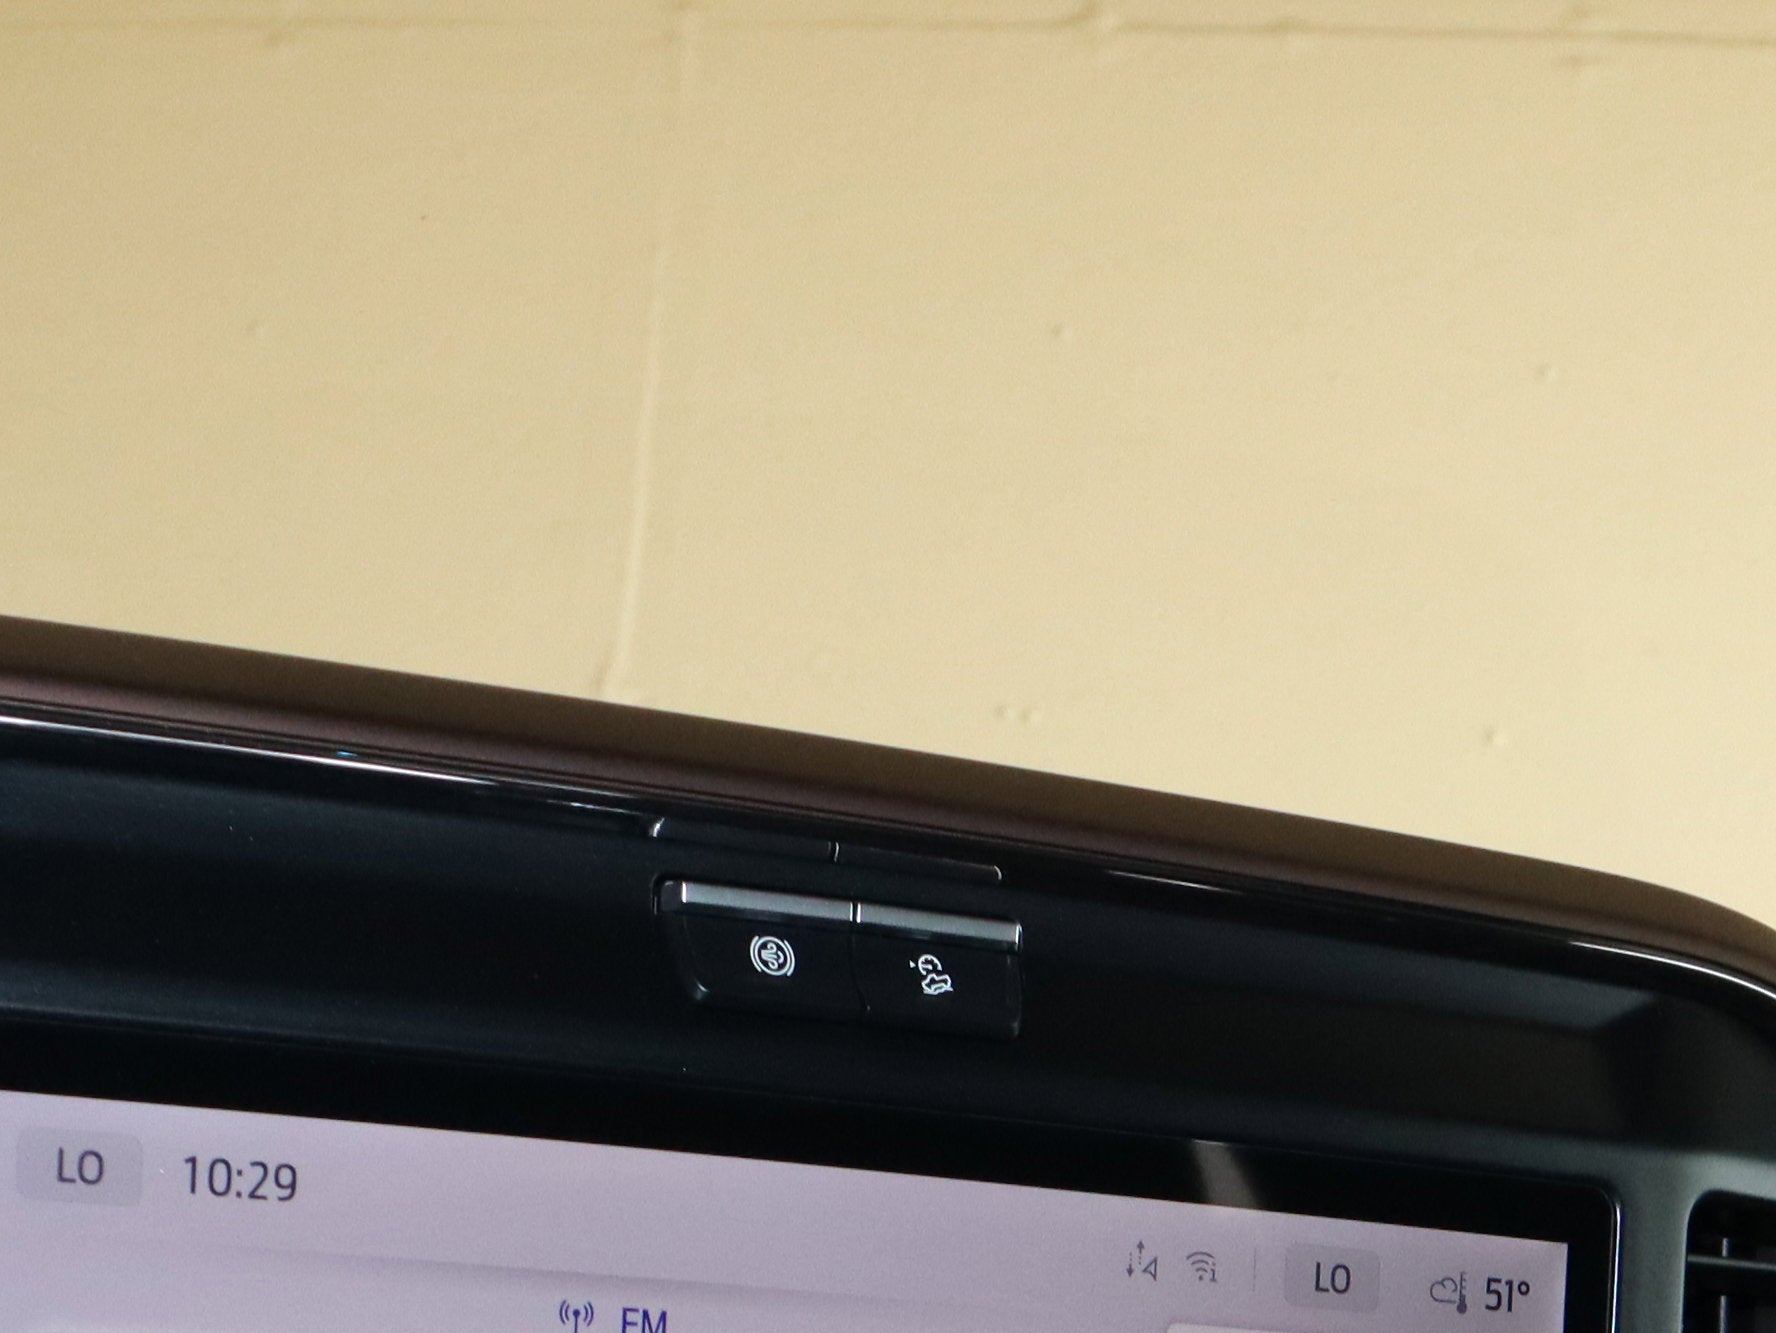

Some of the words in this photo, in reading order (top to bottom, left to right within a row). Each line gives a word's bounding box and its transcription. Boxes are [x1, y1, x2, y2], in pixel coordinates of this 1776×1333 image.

[56, 1149, 105, 1185] LO
[182, 1155, 298, 1201] 10:29
[1313, 1263, 1351, 1294] LO
[1484, 1278, 1530, 1313] 51°
